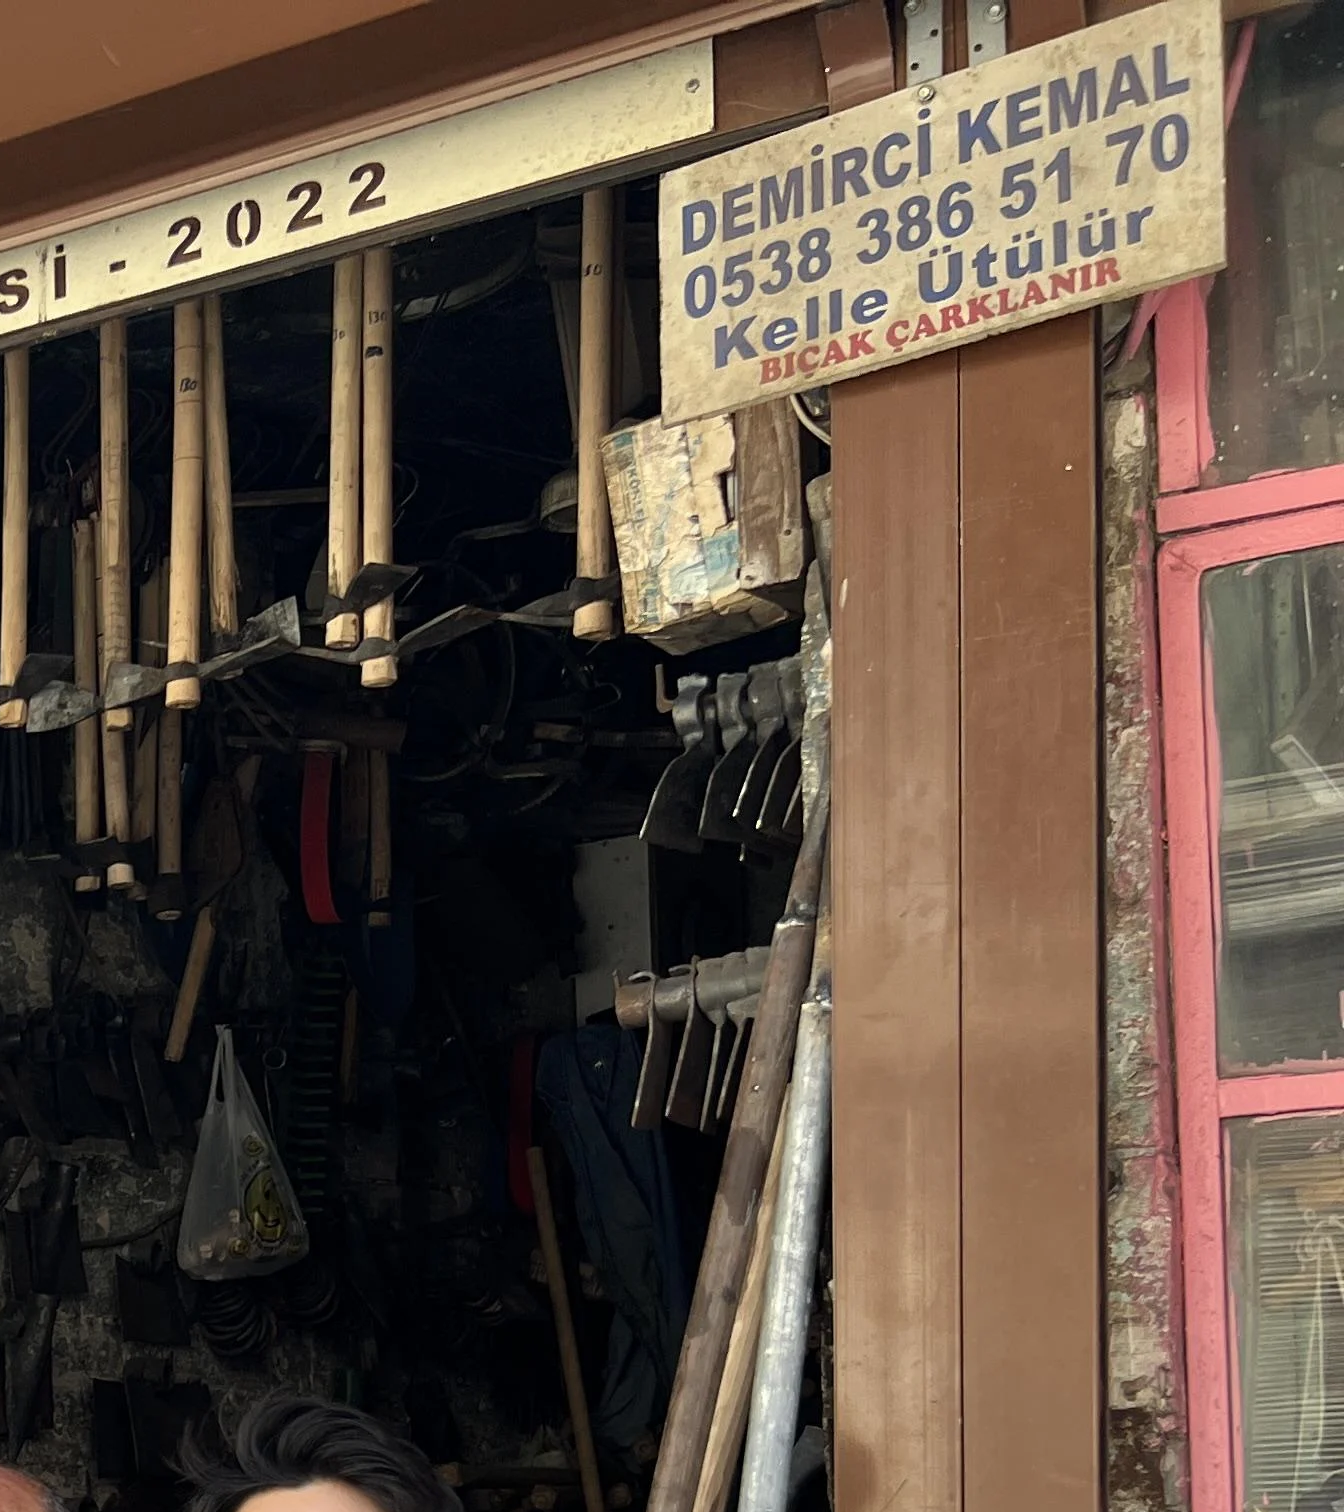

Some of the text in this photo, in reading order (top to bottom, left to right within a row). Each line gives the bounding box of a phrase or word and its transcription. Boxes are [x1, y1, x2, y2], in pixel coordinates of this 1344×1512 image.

[109, 259, 127, 274] -
[167, 161, 386, 268] 2022
[682, 43, 1189, 254] DEMİRCİ KEMAL
[684, 112, 1189, 319] 0538 386 51 70
[714, 205, 1155, 368] Kelle Ütülür
[759, 256, 1122, 385] BIÇAK ÇARKLANIR
